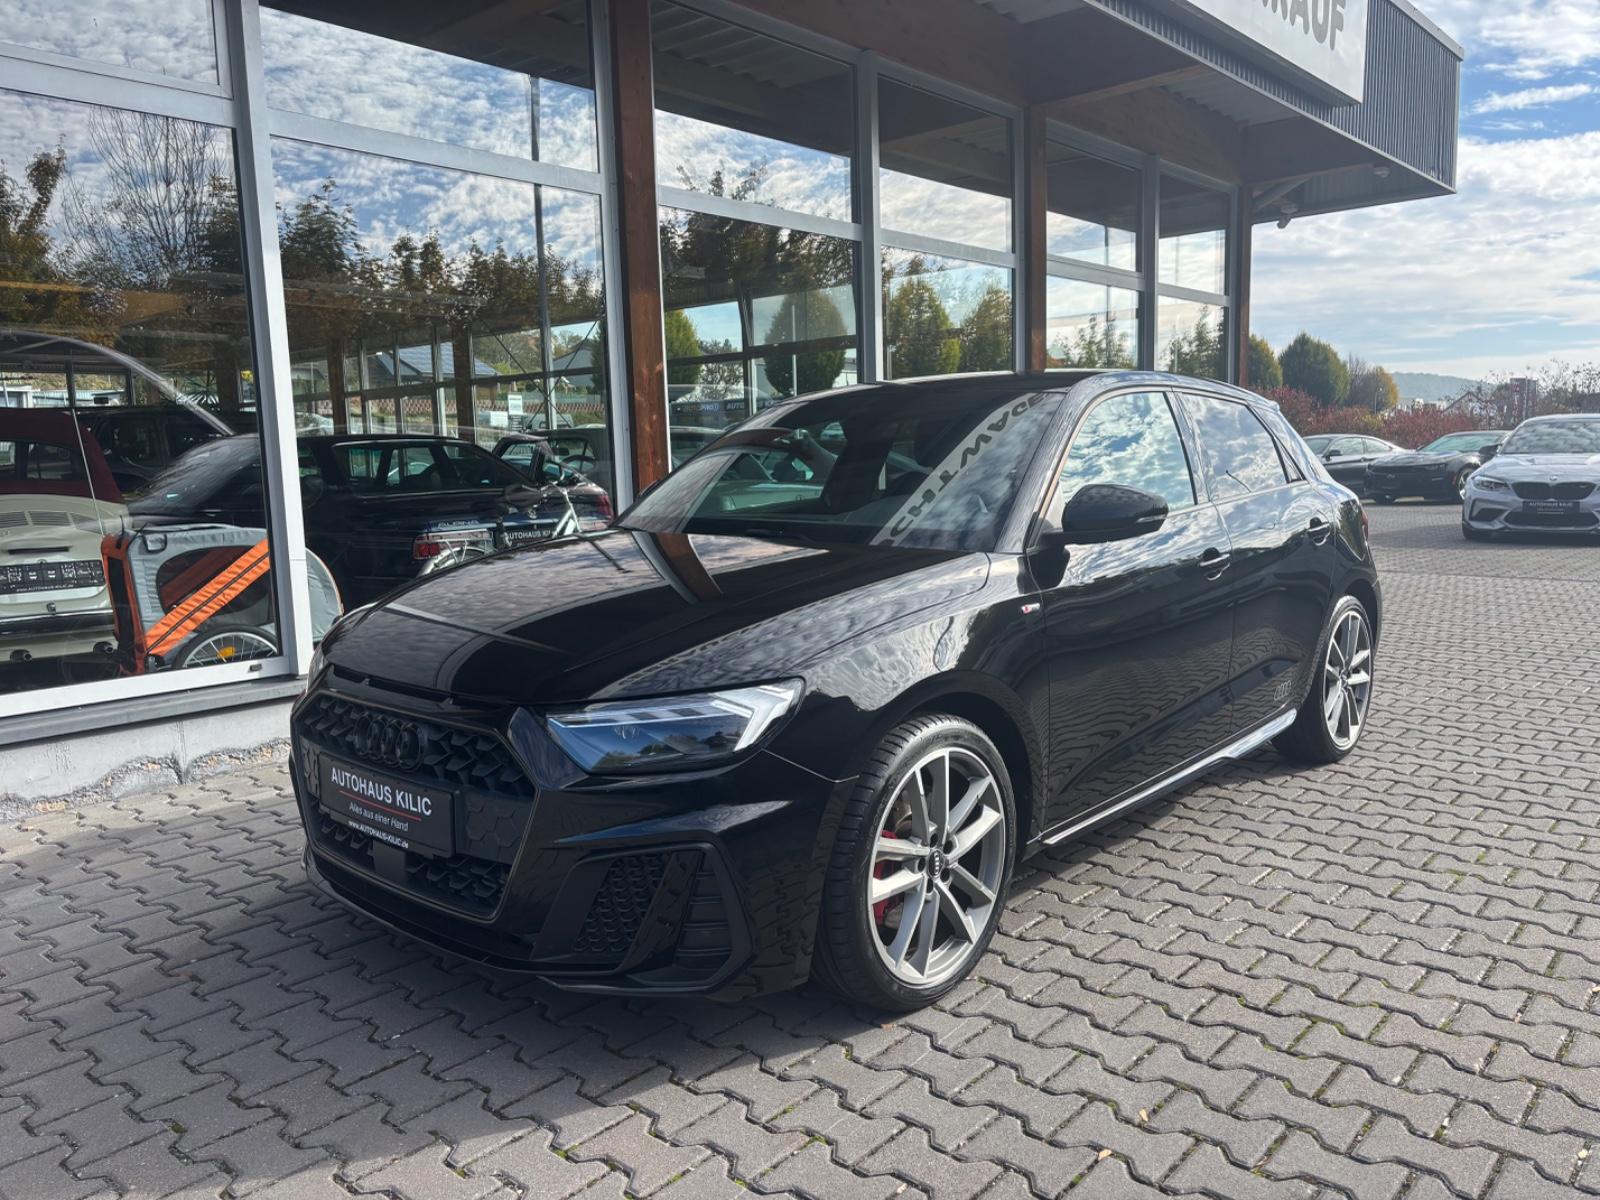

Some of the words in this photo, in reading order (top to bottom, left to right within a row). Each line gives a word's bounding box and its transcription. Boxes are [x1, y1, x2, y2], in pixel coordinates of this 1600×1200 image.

[1262, 0, 1346, 50] AUF
[331, 767, 392, 804] AUTOHAUS
[396, 789, 432, 816] KILIC
[349, 801, 363, 815] Alles
[363, 808, 374, 820] aus
[374, 813, 390, 825] einer
[391, 817, 409, 832] Hand
